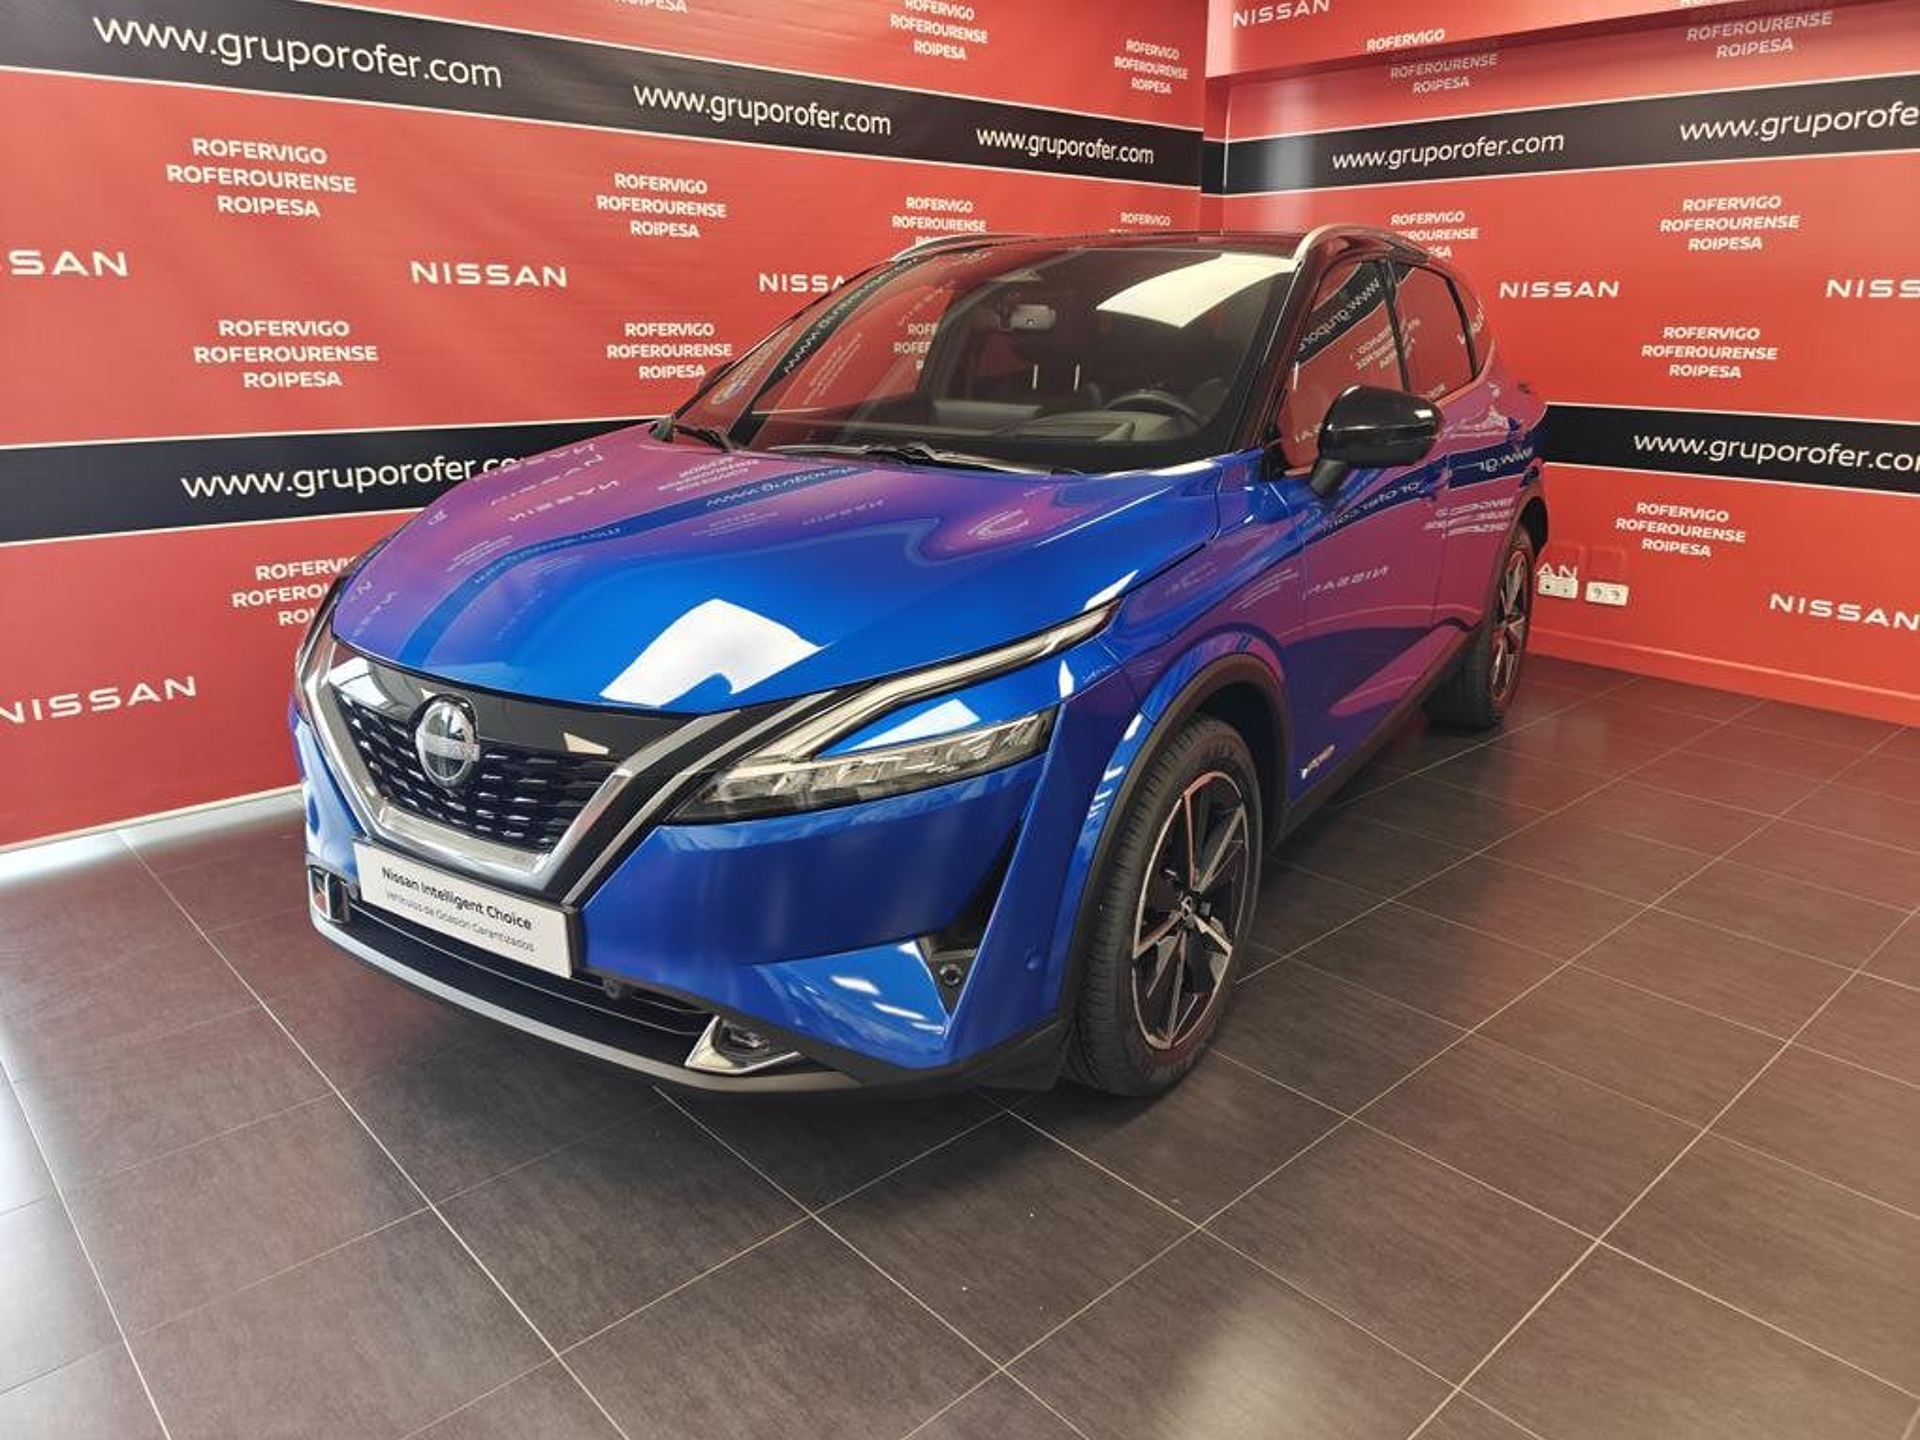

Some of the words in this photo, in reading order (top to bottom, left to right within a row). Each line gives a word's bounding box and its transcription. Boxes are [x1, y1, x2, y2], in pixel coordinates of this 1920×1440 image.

[905, 0, 974, 20] ROFERVIGO
[1233, 0, 1329, 27] NISSAN
[890, 14, 987, 43] ROFEROURENSE
[1686, 11, 1833, 41] ROFEROURENSE
[914, 40, 966, 60] ROIPESA
[1126, 39, 1179, 60] ROFERVIGO
[1367, 28, 1445, 52] ROFERVIGO
[1717, 38, 1793, 58] ROIPESA
[94, 17, 501, 88] www.gruporofer.com
[1114, 56, 1188, 80] ROFEROURENSE
[1391, 53, 1497, 79] ROFEROURENSE
[1413, 76, 1469, 93] ROIPESA
[634, 85, 891, 135] www.gruporofer.com
[192, 137, 327, 165] ROFERVIGO
[976, 128, 1154, 165] www.gruporofer.com
[1332, 132, 1564, 169] www.gruporofer.com
[167, 165, 357, 193] ROFEROURENSE
[615, 172, 707, 194] ROFERVIGO
[218, 194, 320, 217] ROIPESA
[597, 195, 726, 218] ROFEROURENSE
[906, 196, 973, 213] ROFERVIGO
[1683, 195, 1781, 212] ROFERVIGO
[892, 215, 986, 232] ROFEROURENSE
[1391, 210, 1465, 225] ROFERVIGO
[1660, 215, 1800, 232] ROFEROURENSE
[630, 220, 700, 238] ROIPESA
[1688, 236, 1762, 251] ROIPESA
[0, 250, 128, 276] SAN
[411, 261, 567, 287] NISSAN
[759, 273, 845, 292] NISSA
[1500, 280, 1620, 299] NISSAN
[219, 320, 350, 337] ROFERVIGO
[625, 322, 715, 337] ROFERVIGO
[1663, 326, 1761, 341] ROFERVIGO
[193, 345, 378, 363] ROFEROURENSE
[607, 344, 732, 359] ROFEROURENSE
[1641, 344, 1777, 360] ROFEROURENSE
[243, 370, 342, 388] ROIPESA
[639, 364, 705, 379] ROIPESA
[1669, 364, 1741, 379] ROIPESA
[1634, 436, 1920, 471] www.gruporofer.co
[1636, 502, 1729, 522] ROFERVIGO
[1615, 518, 1746, 542] ROFEROURENSE
[1642, 538, 1712, 558] ROIPESA
[1770, 593, 1920, 630] NISSAN
[0, 676, 197, 723] NISSAN
[382, 867, 420, 891] Nissan
[421, 883, 484, 915] Intelligent
[486, 905, 532, 930] Choice
